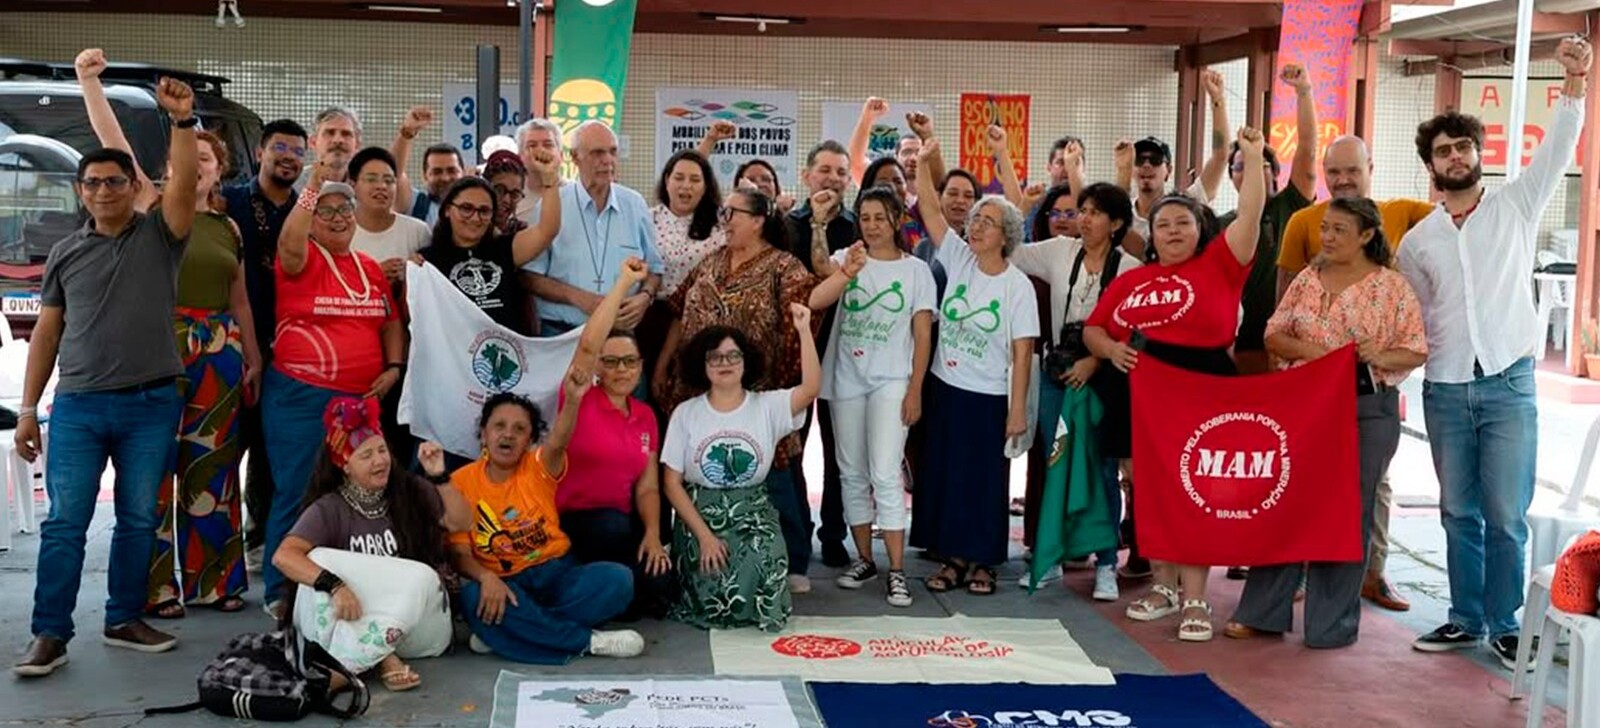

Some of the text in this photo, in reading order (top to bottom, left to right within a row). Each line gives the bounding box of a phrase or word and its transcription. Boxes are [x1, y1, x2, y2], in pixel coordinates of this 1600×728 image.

[739, 127, 757, 141] DOS
[759, 128, 791, 142] POVOS
[728, 143, 734, 155] E
[735, 143, 757, 155] PELO
[759, 143, 789, 157] CLIMA
[1121, 289, 1182, 310] MAM
[1200, 412, 1256, 433] SOBERANIA
[1184, 429, 1203, 453] PELA
[1195, 448, 1277, 478] MAM
[1180, 453, 1205, 507] MOVIMENTO
[1261, 457, 1291, 510] MINERAÇÃO
[1216, 509, 1253, 519] BRASIL
